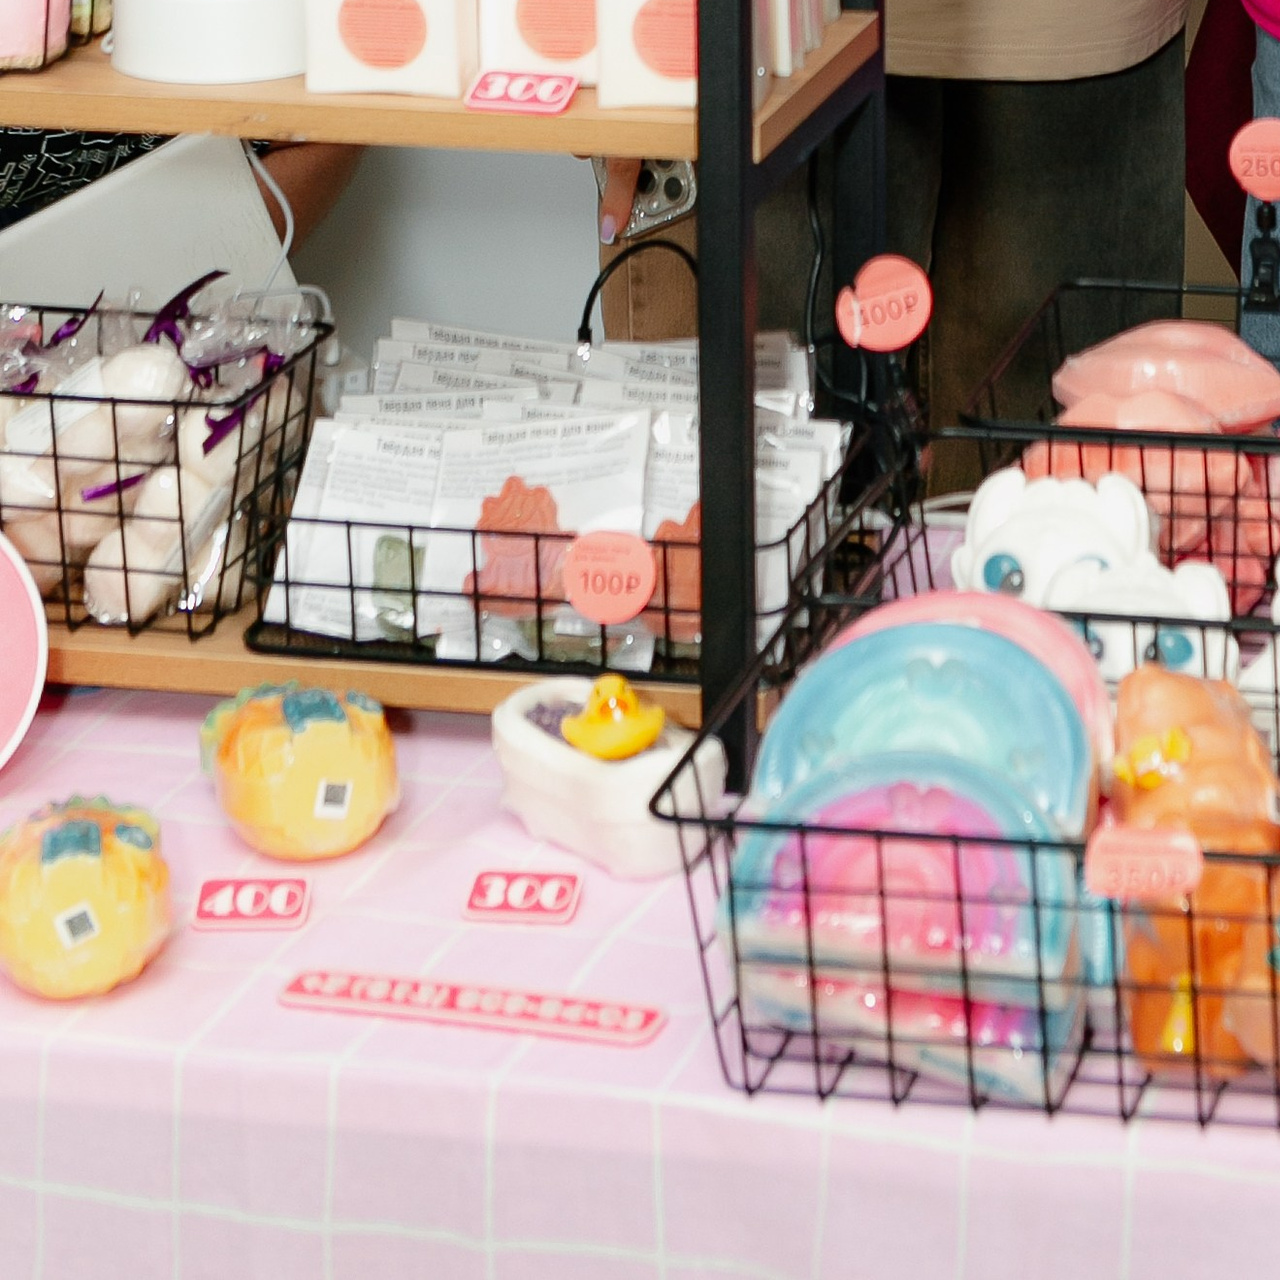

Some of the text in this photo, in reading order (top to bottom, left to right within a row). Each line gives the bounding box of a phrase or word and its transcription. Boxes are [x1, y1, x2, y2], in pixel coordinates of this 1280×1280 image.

[474, 74, 568, 104] 300
[202, 884, 304, 917] 400
[471, 876, 576, 911] 300
